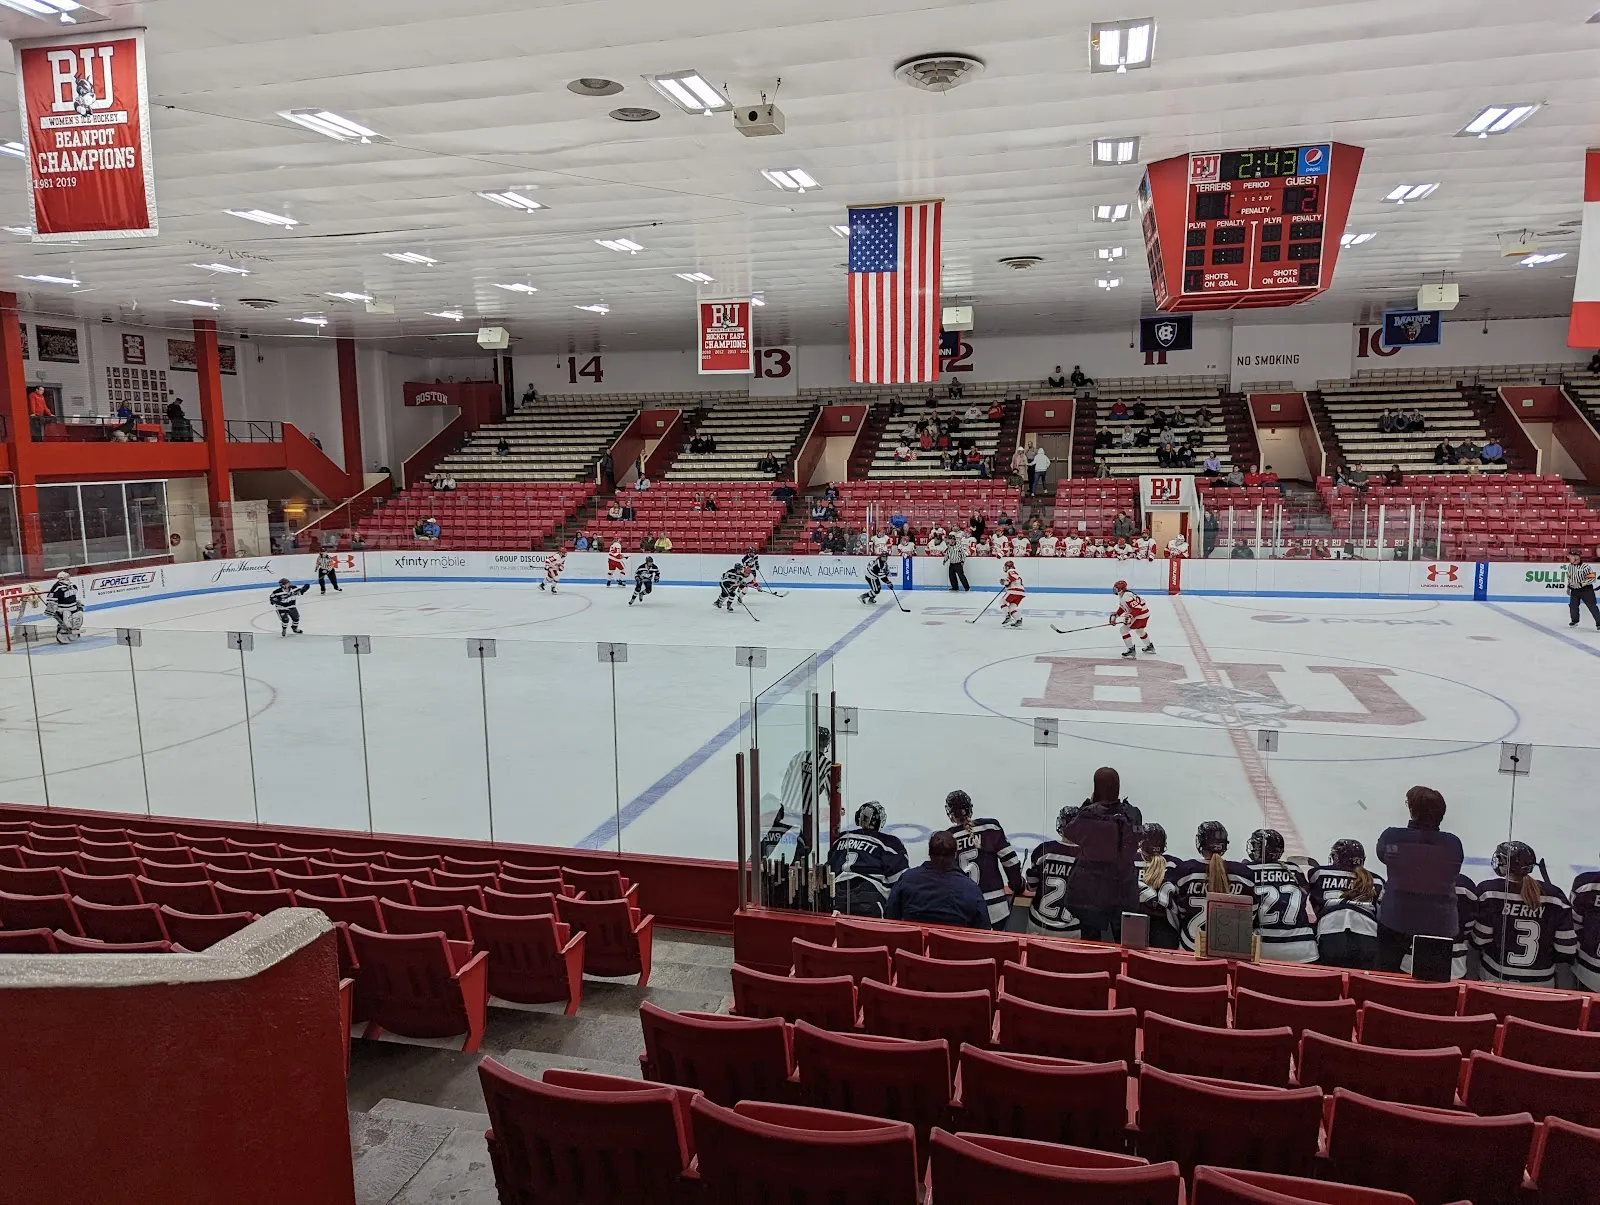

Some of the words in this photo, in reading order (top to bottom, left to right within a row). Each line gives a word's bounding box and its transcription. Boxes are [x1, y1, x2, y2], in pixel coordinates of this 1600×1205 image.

[47, 46, 114, 112] BU
[48, 116, 80, 126] WOMEN'S
[81, 115, 92, 124] ICE
[93, 113, 118, 124] HOCKEY
[56, 128, 114, 148] BEANPOT
[38, 147, 136, 174] CHAMPIONS
[1192, 156, 1220, 178] BU
[1239, 150, 1296, 178] 2:43
[34, 178, 53, 189] 1981
[56, 177, 77, 188] 2019
[1196, 182, 1232, 192] TERRIERS
[1243, 181, 1270, 189] PERIOD
[1286, 176, 1318, 186] GUEST
[1224, 194, 1228, 216] 1
[1302, 188, 1316, 212] 2
[712, 304, 740, 327] BU
[1394, 315, 1431, 327] MAINE
[705, 340, 747, 349] CHAMPIONS
[754, 349, 791, 378] 13
[1237, 356, 1251, 366] NO
[1255, 354, 1300, 366] SMOKING
[568, 356, 604, 384] 14
[416, 392, 448, 405] BOSTON
[1151, 478, 1181, 499] BU
[395, 556, 428, 568] xfinity
[431, 556, 465, 568] mobile
[212, 562, 236, 582] John
[237, 560, 274, 574] Hancock
[773, 565, 812, 577] AQUAFINA
[818, 566, 858, 577] AQUAFINA
[100, 577, 129, 587] SPORTS
[132, 574, 148, 582] ETC.
[1020, 655, 1426, 726] BU
[837, 840, 878, 854] HARNETT
[956, 834, 981, 850] ETON
[1254, 870, 1297, 882] LEGROS
[1039, 876, 1074, 921] 2
[1254, 885, 1302, 925] 27
[1502, 903, 1546, 918] BERRY
[1507, 920, 1540, 966] 3
